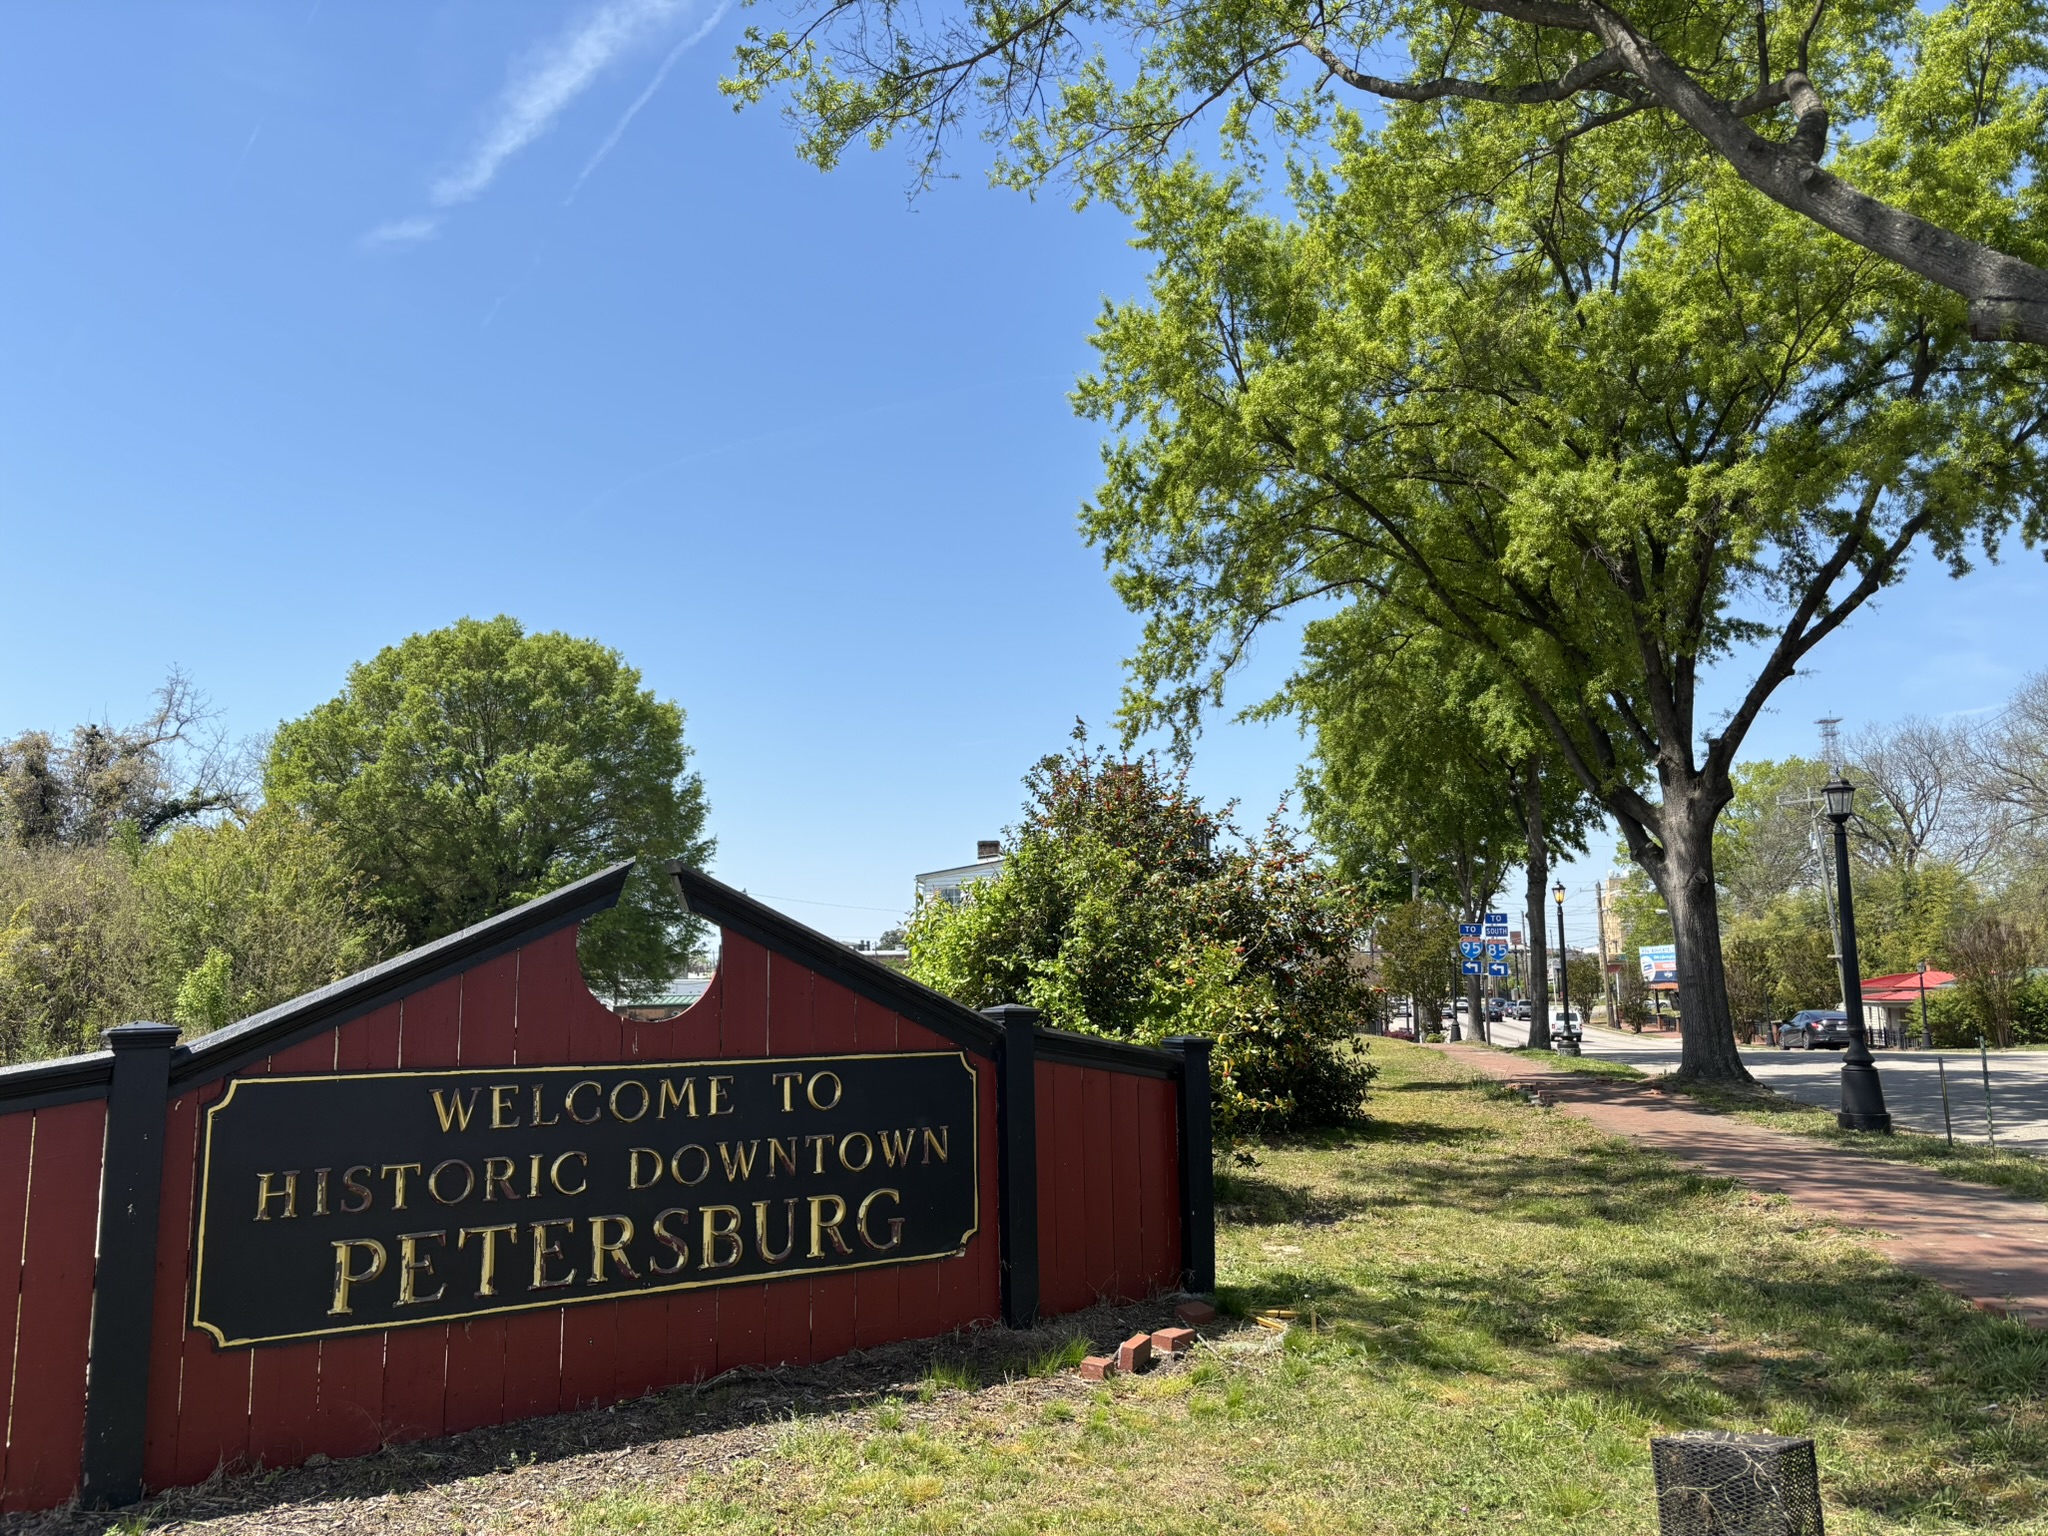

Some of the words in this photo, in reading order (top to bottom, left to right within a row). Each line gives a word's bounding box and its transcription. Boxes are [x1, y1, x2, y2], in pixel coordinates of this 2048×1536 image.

[1461, 941, 1481, 954] 95
[1488, 944, 1507, 956] 85
[430, 1075, 735, 1133] WELCOME
[772, 1070, 842, 1111] TO
[253, 1151, 588, 1222] HISTORIC
[628, 1125, 949, 1190] DOWNTOWN
[326, 1188, 906, 1316] PETERSBURG
